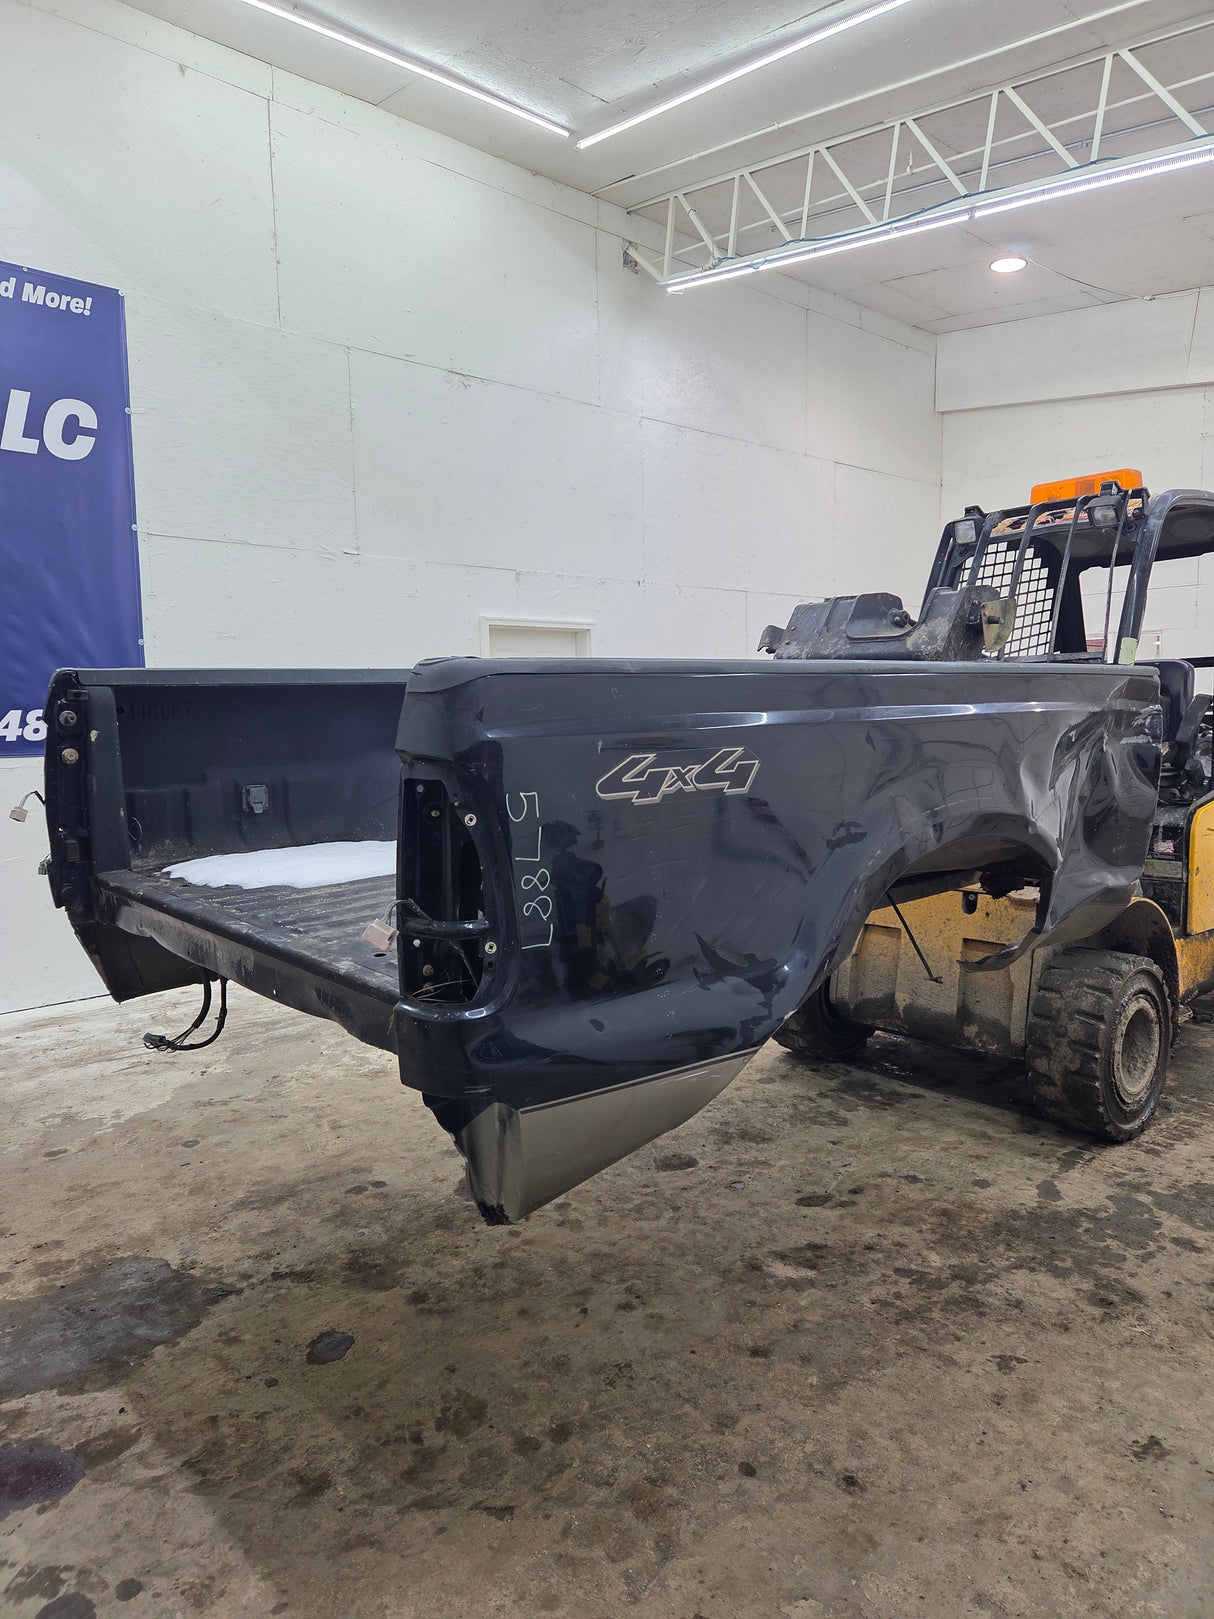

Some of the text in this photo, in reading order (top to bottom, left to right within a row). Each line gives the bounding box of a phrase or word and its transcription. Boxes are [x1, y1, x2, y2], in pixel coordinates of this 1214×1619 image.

[22, 282, 93, 316] More!
[0, 388, 98, 461] LC
[0, 709, 47, 742] 48
[596, 747, 760, 806] 4x4
[505, 791, 553, 950] 57887
